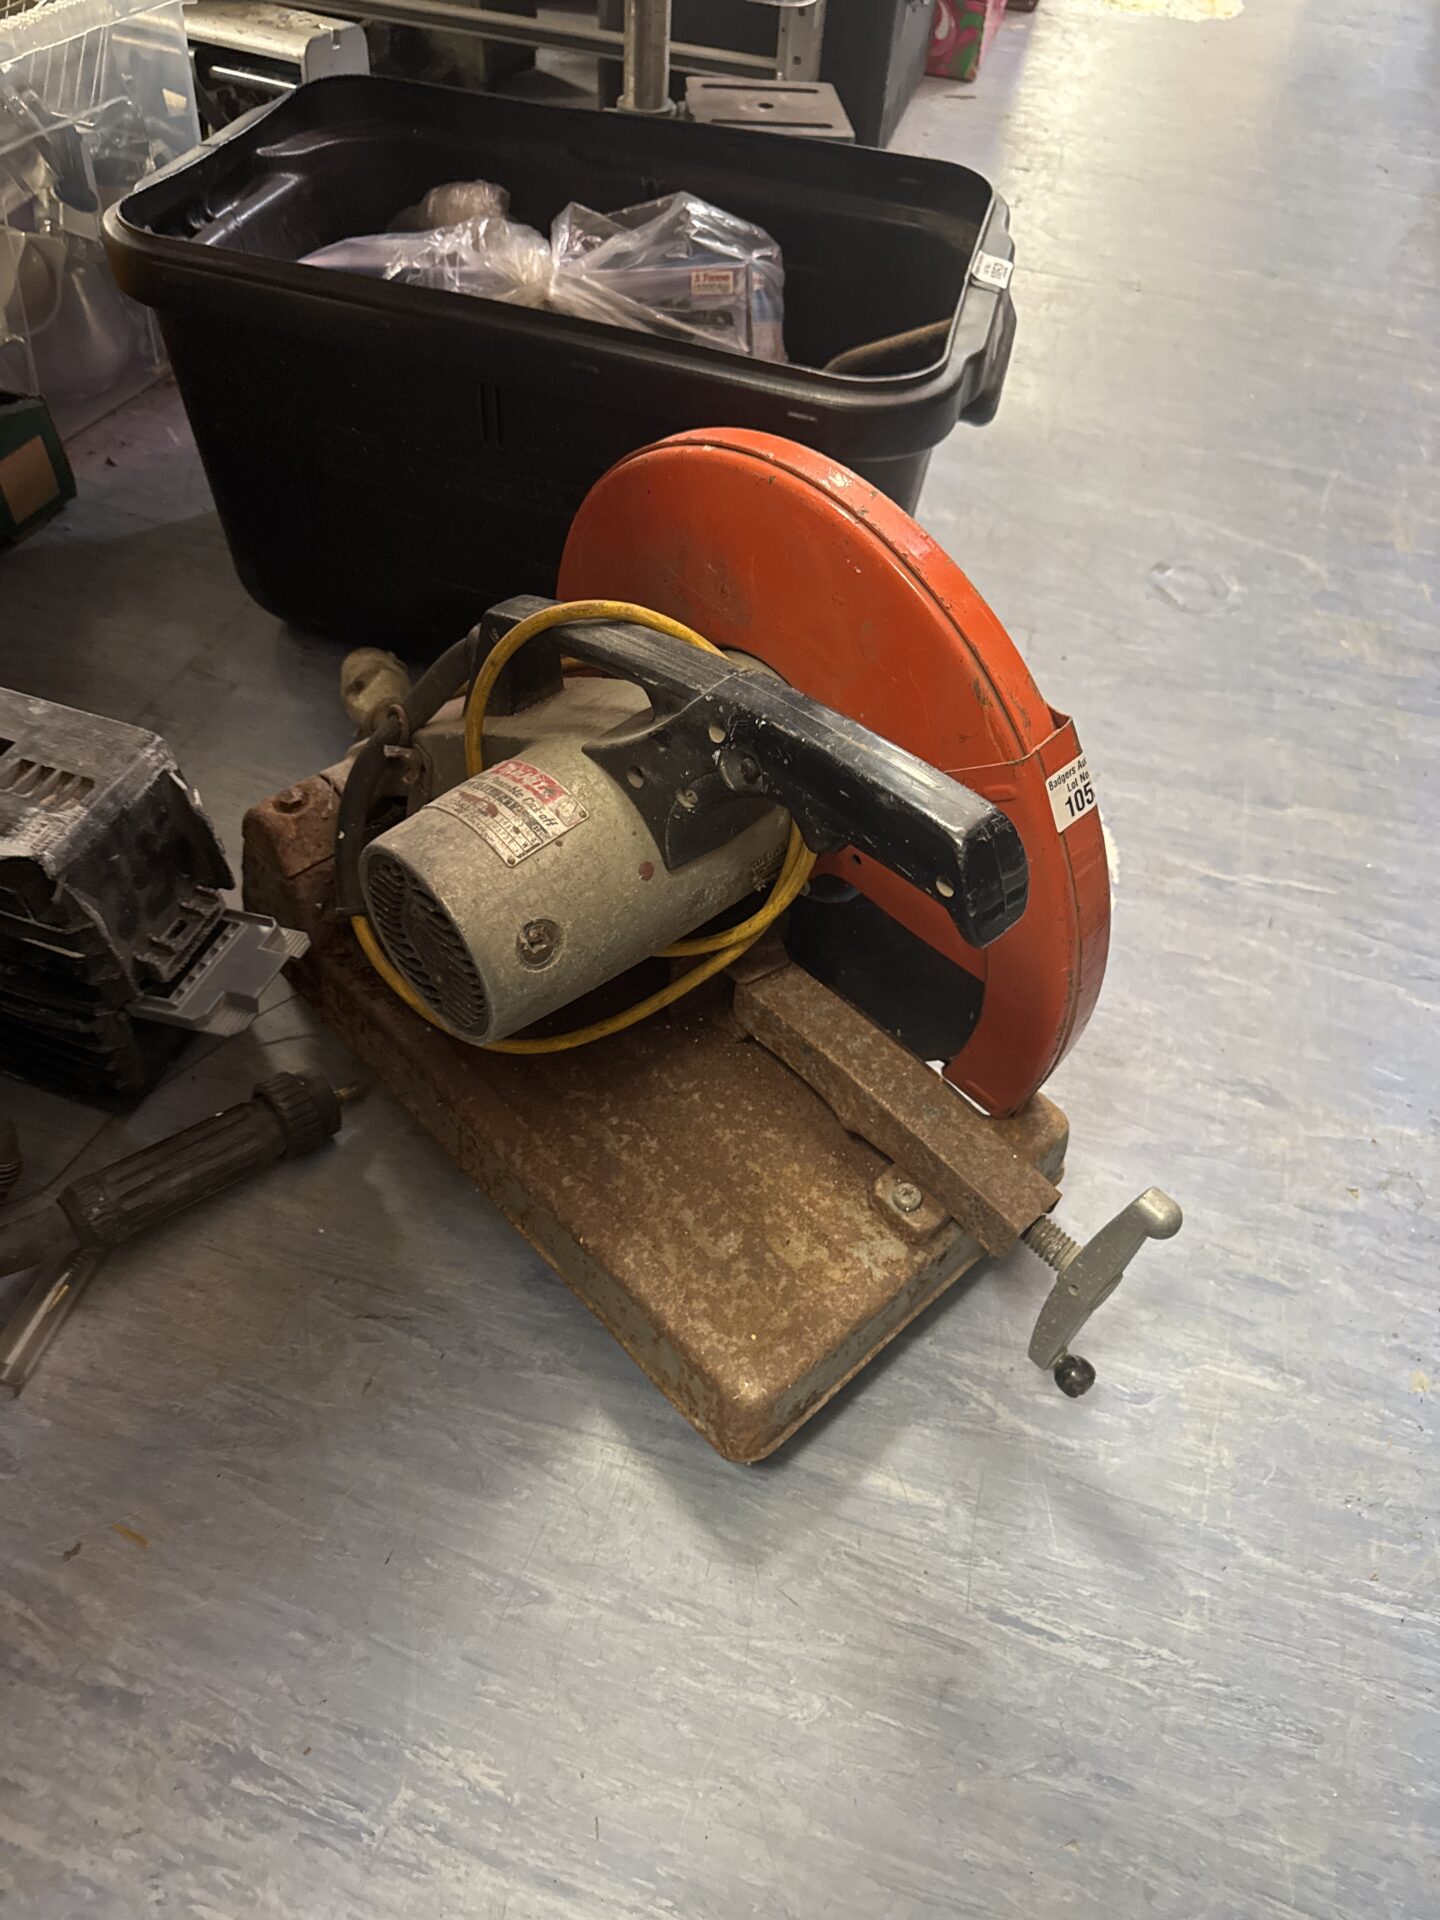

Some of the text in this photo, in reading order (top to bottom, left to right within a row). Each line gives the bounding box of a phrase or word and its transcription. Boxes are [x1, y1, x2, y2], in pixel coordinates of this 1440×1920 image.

[1048, 756, 1088, 791] Badgers Au
[1066, 778, 1078, 792] Lot
[1065, 781, 1095, 817] 105
